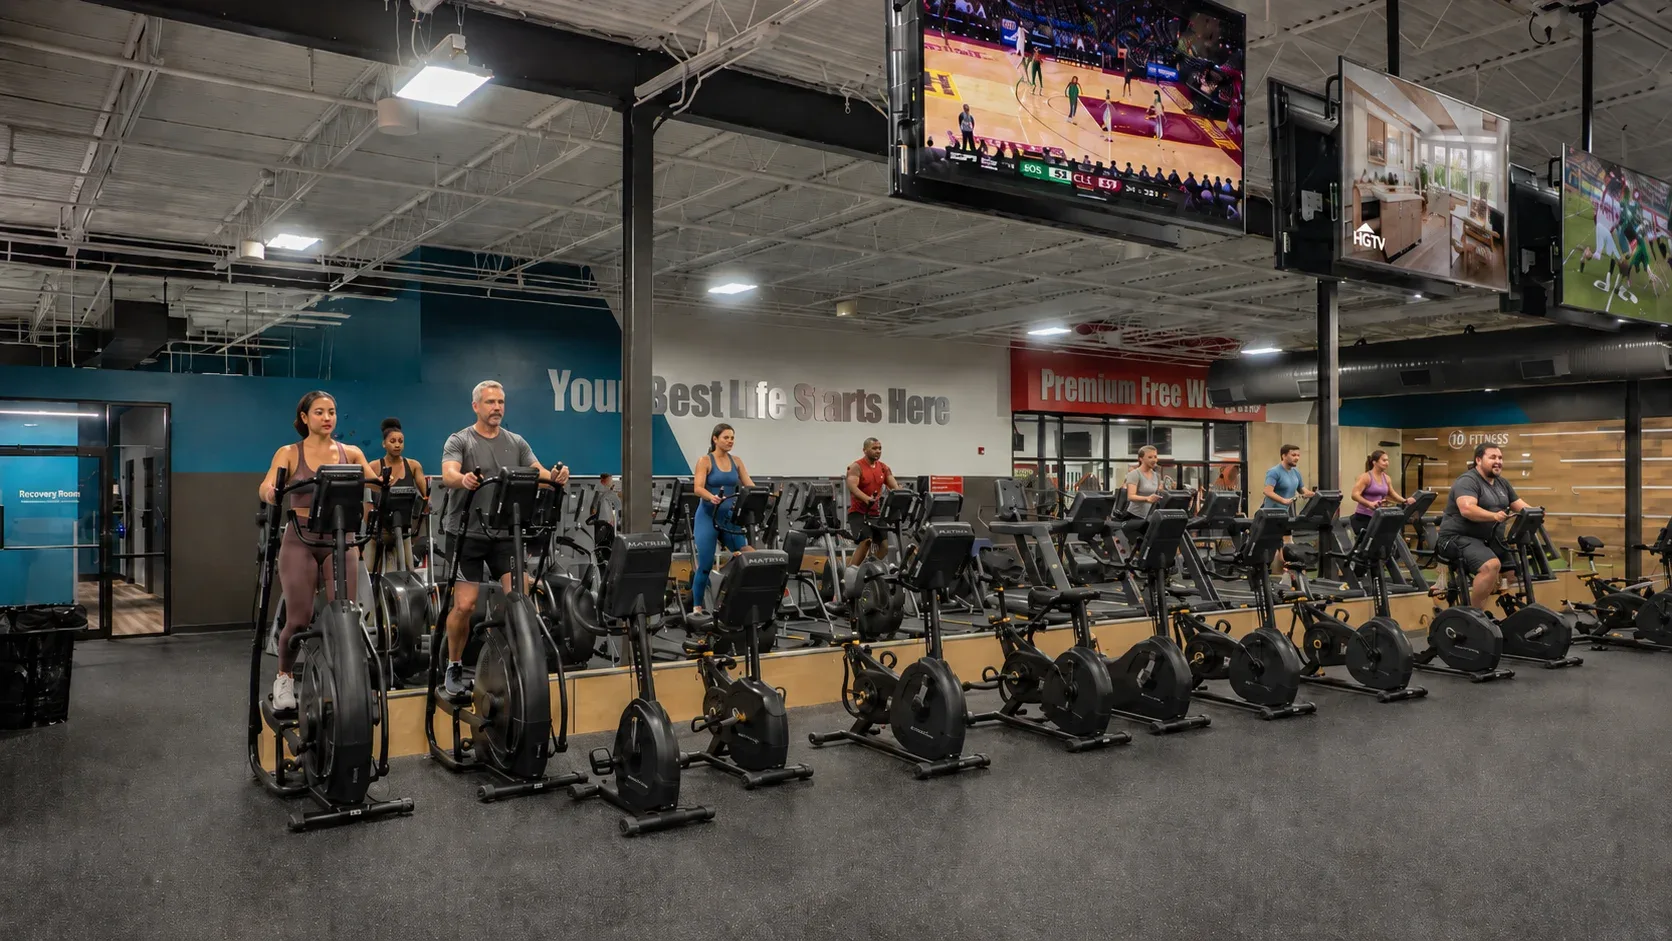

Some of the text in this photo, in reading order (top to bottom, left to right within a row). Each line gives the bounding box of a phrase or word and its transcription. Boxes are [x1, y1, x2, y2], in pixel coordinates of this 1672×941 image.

[1353, 230, 1386, 251] HGTV
[548, 369, 950, 426] You Best Life Starts Here
[1041, 368, 1136, 404] Premium
[1141, 376, 1181, 408] Free
[1469, 433, 1509, 445] FITNESS
[19, 490, 80, 499] Recovery Room
